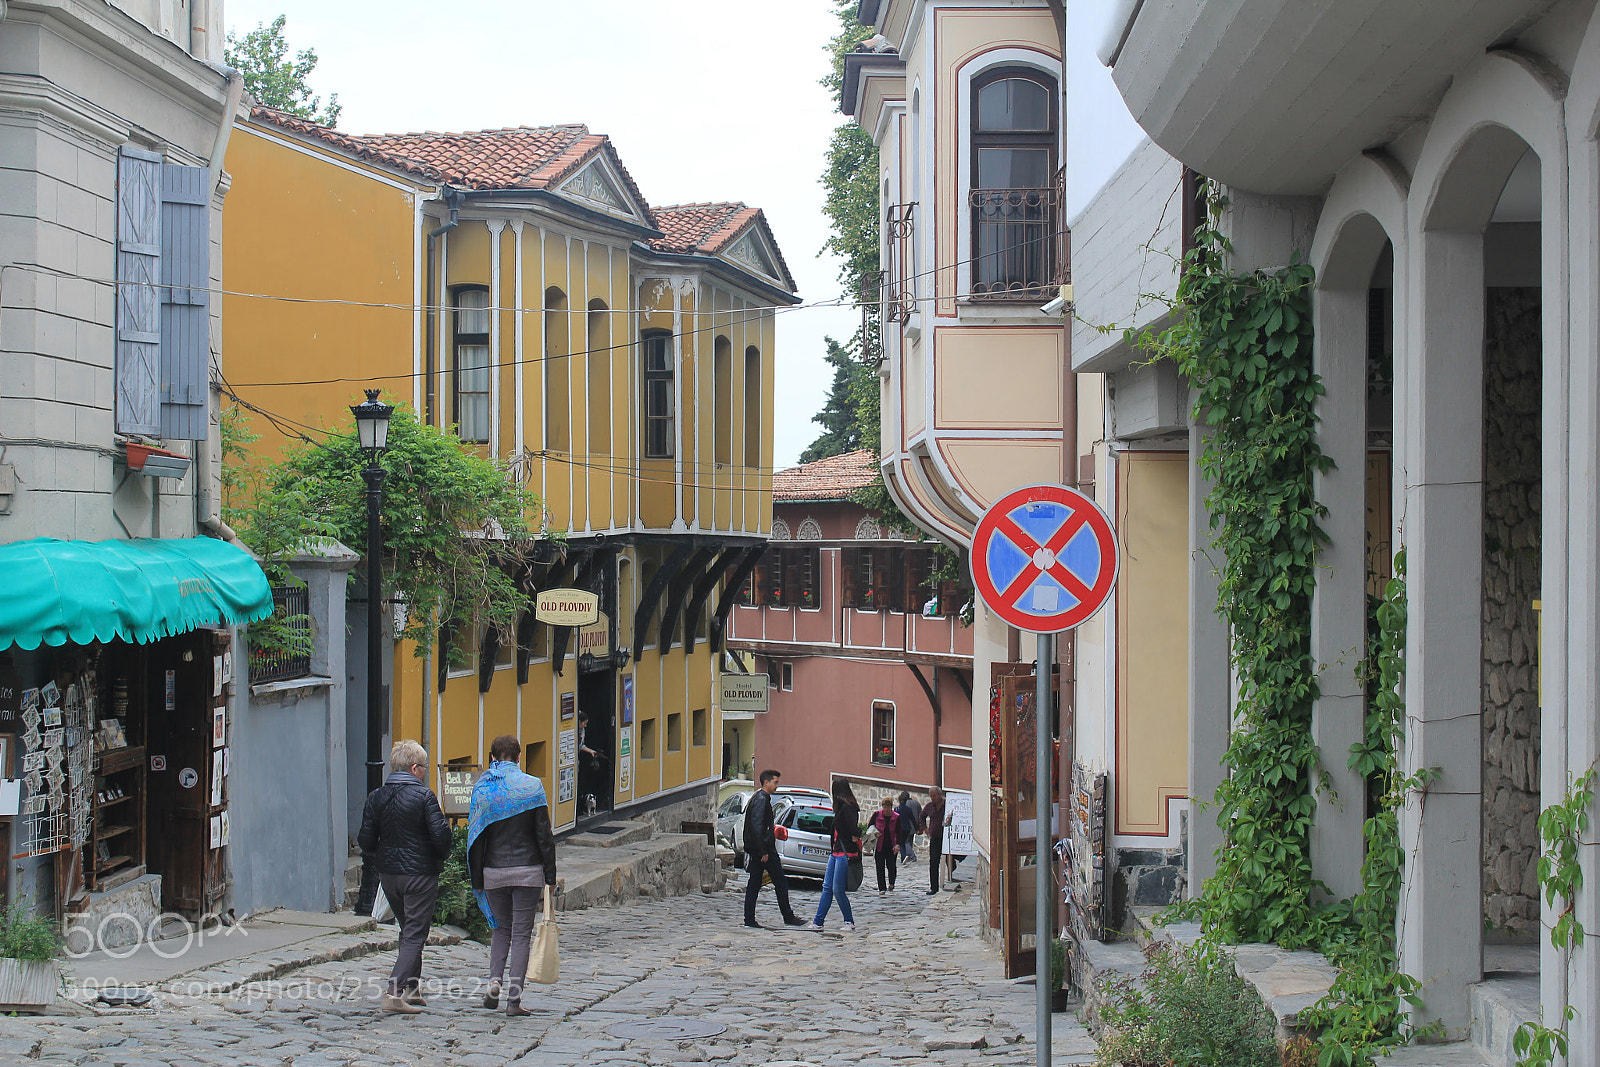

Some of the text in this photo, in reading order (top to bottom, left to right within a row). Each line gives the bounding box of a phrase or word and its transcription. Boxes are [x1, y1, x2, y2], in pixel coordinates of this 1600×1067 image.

[541, 602, 592, 612] OLD PLOVDIV
[580, 631, 607, 648] OLD PLOVDIV
[724, 690, 763, 699] OLD PLOVDIV
[446, 772, 473, 785] Bed &
